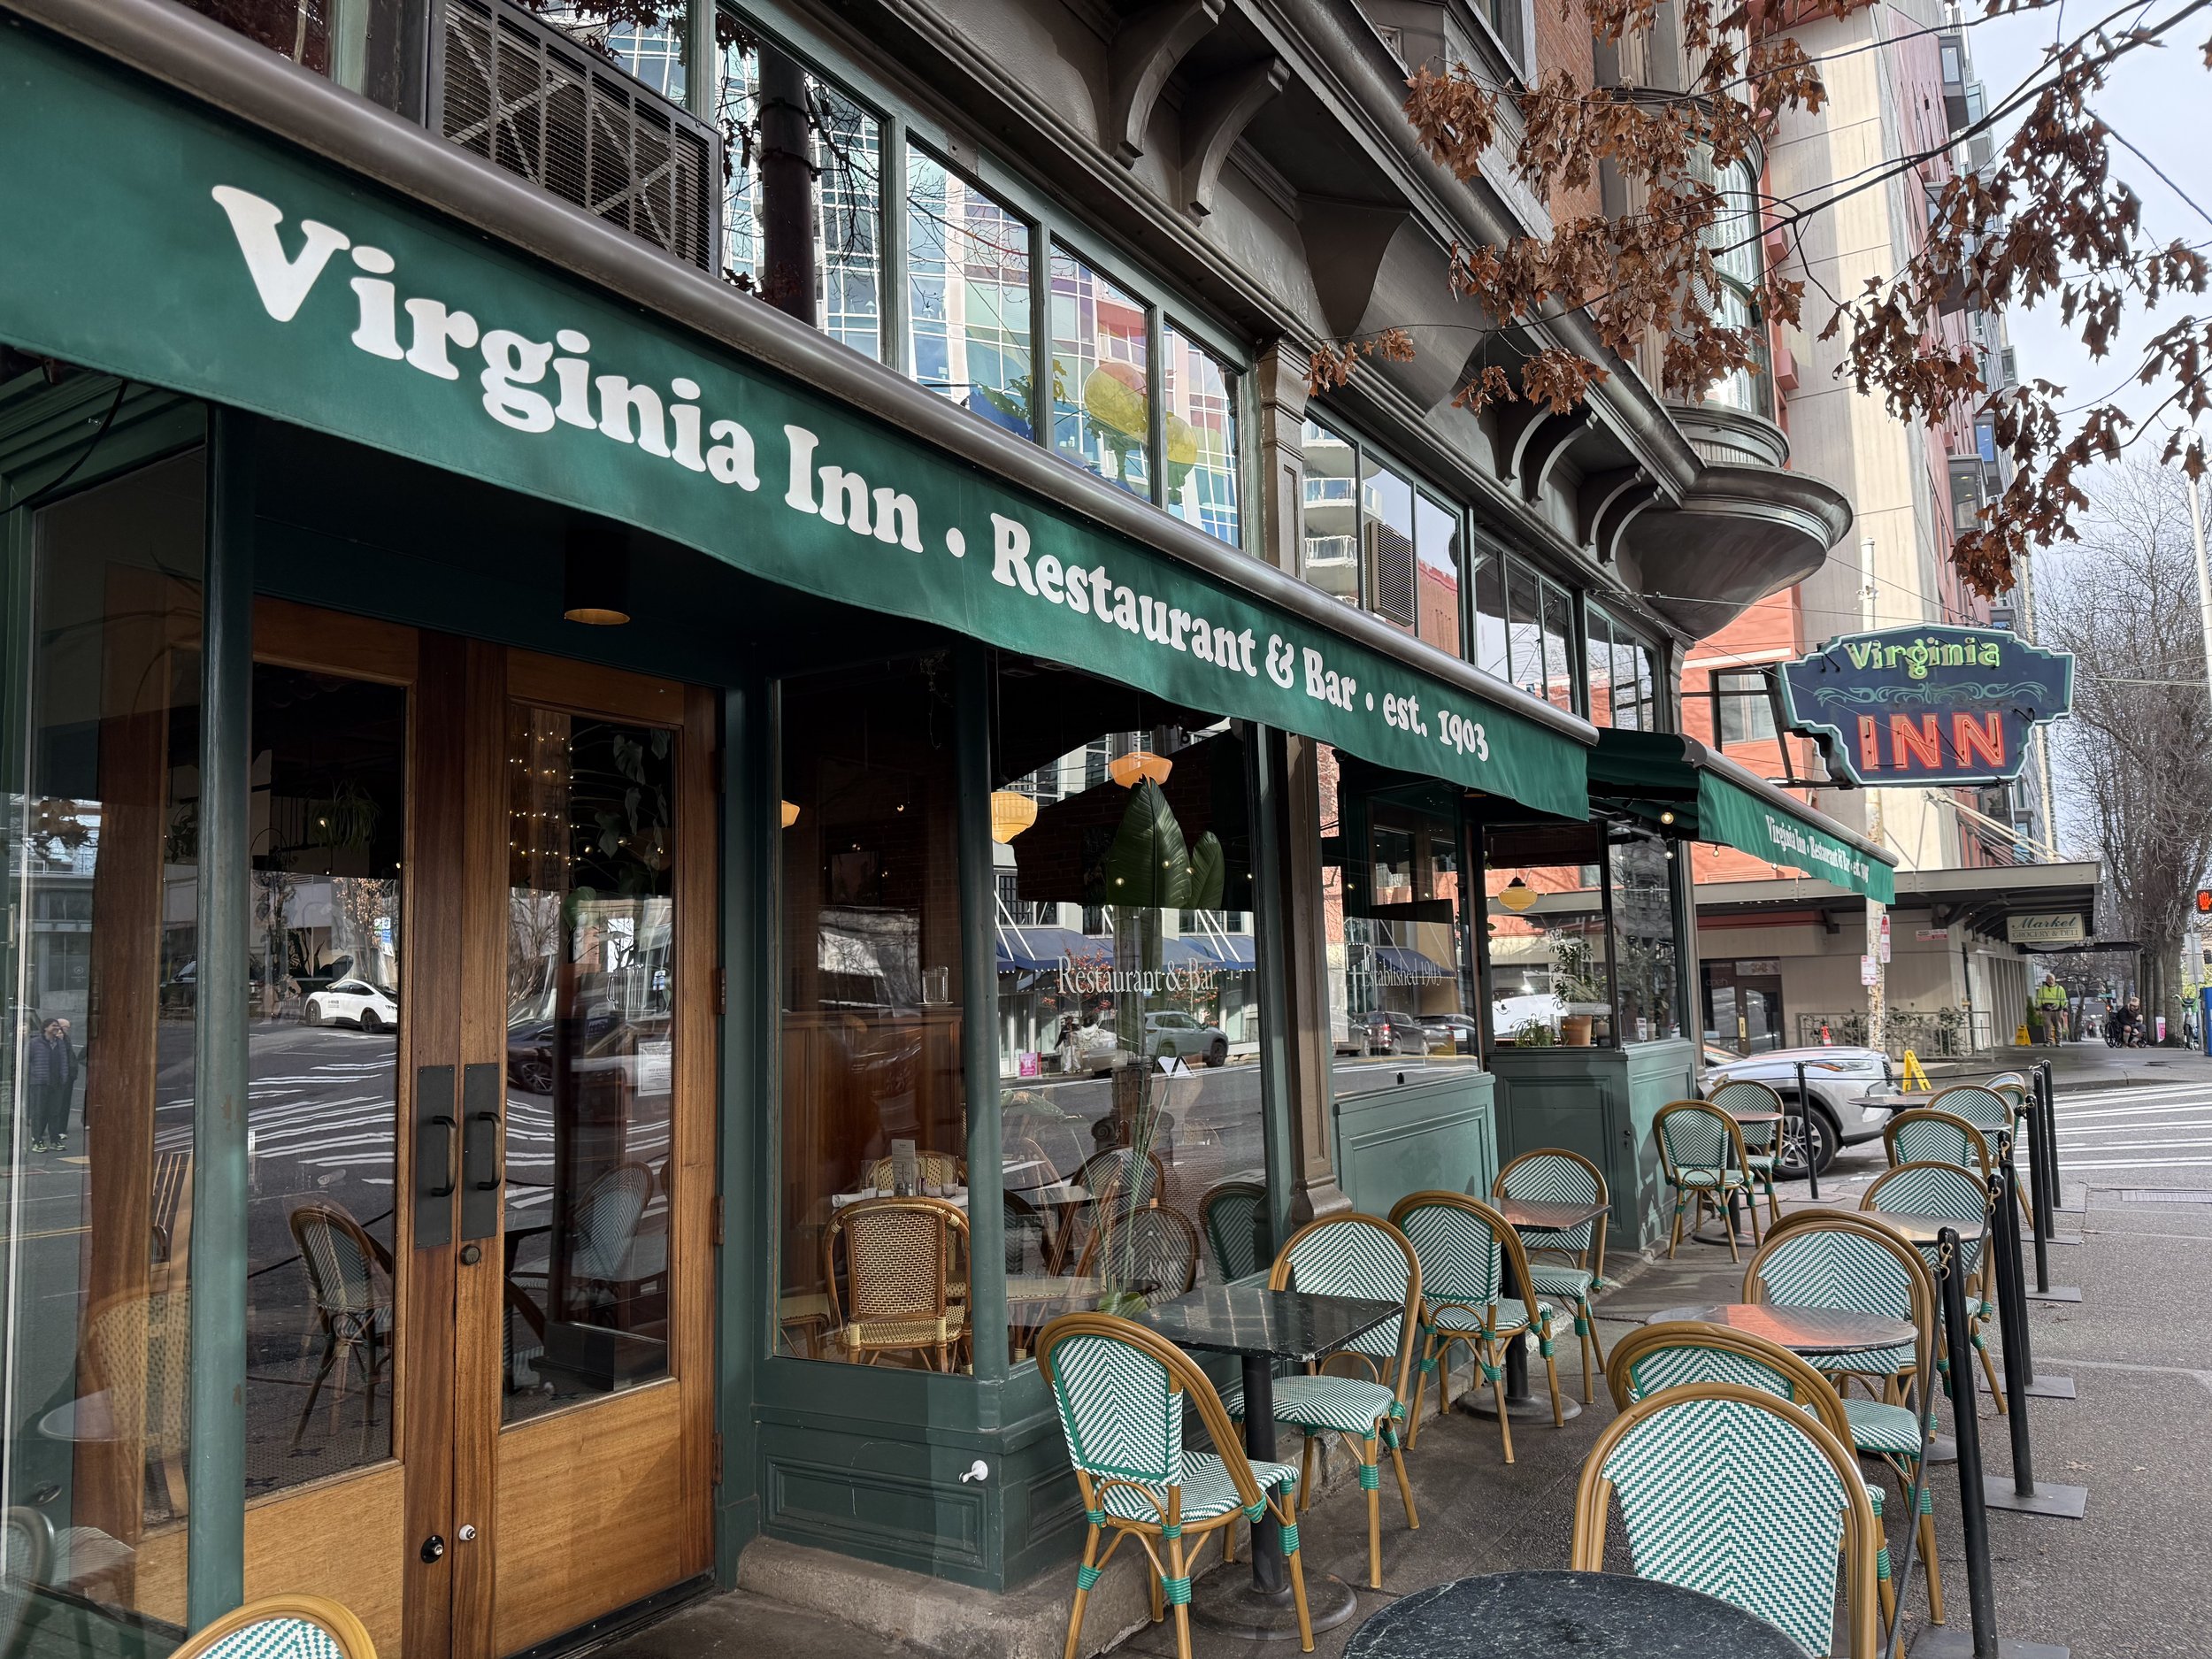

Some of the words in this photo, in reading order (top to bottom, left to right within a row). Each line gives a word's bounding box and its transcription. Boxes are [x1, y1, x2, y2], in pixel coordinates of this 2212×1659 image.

[211, 184, 761, 492] Virginia
[784, 424, 924, 553] Inn
[990, 512, 1257, 677] Restaurant
[1265, 634, 1294, 688] &
[1302, 647, 1356, 711] Bar
[1383, 692, 1427, 738] est.
[1438, 710, 1489, 762] 1903
[1844, 636, 2001, 680] Virginia
[1858, 710, 2005, 772] INN
[1765, 814, 1797, 852] Virginia
[2012, 916, 2077, 929] Market
[2012, 930, 2050, 939] GROCERY
[1056, 956, 1162, 994] Restaurant
[1165, 960, 1184, 992] &
[1187, 957, 1216, 992] Bar
[1362, 957, 1419, 987] Established
[1420, 961, 1442, 987] 1903
